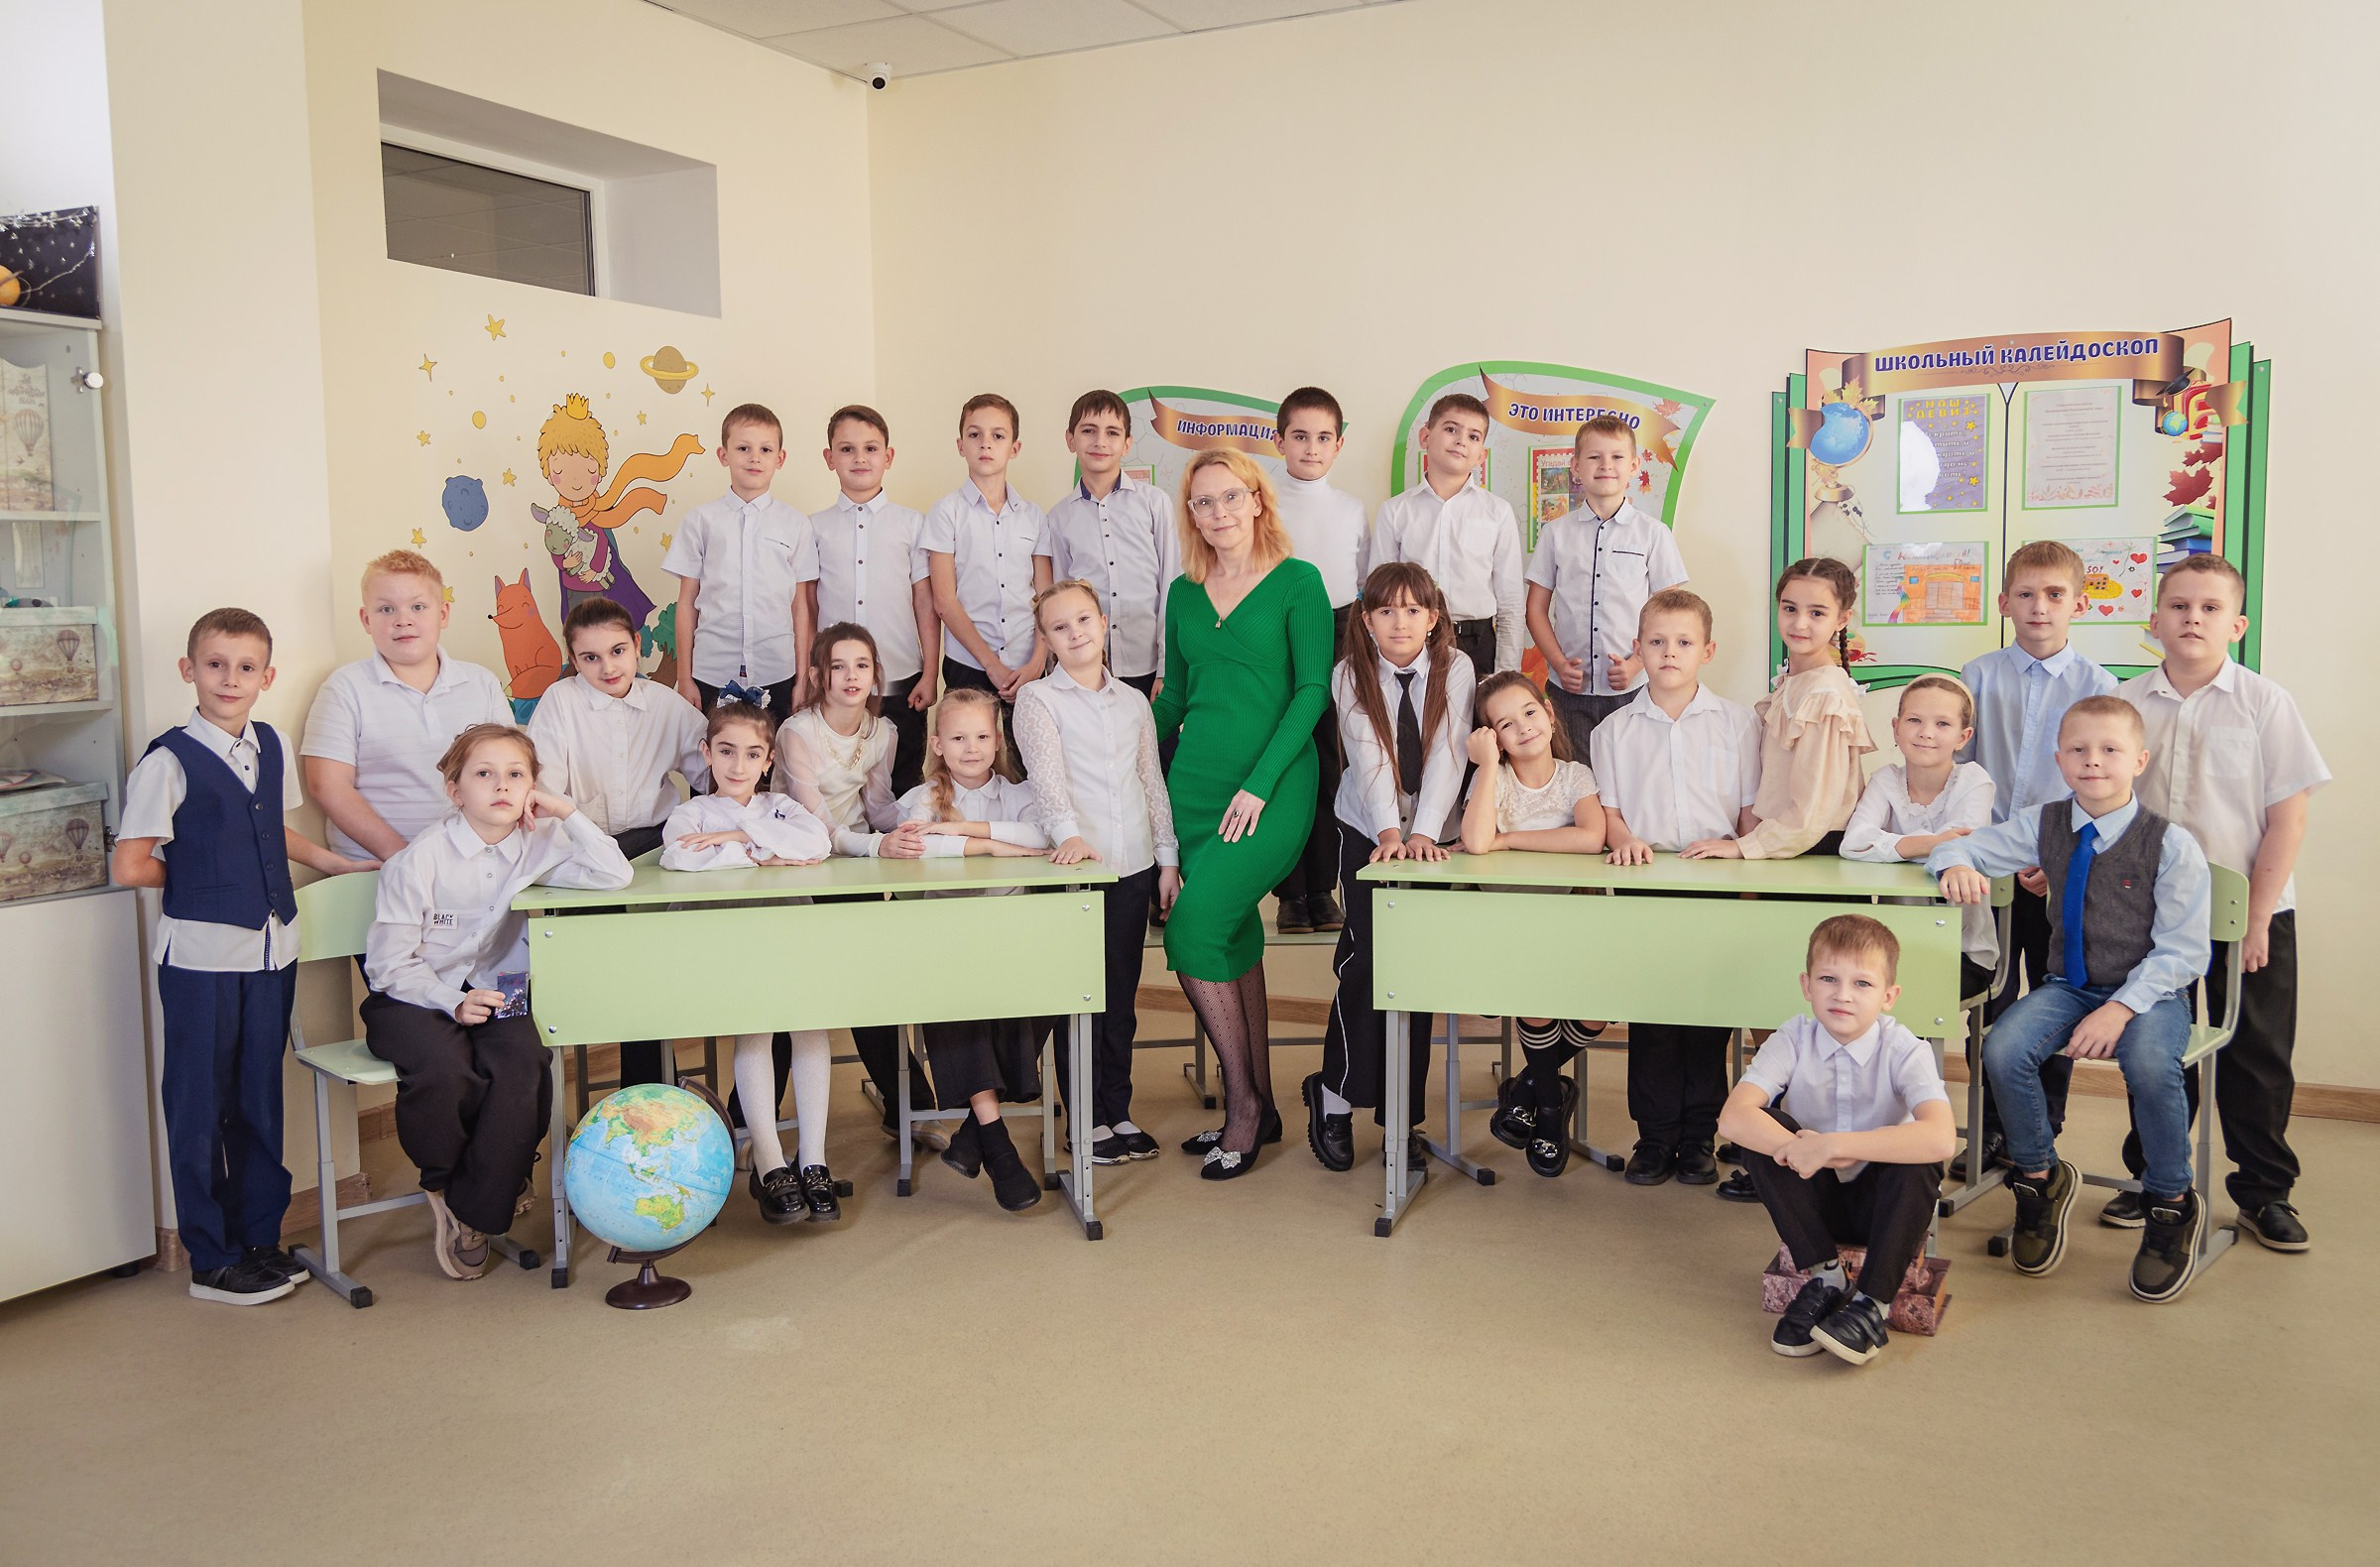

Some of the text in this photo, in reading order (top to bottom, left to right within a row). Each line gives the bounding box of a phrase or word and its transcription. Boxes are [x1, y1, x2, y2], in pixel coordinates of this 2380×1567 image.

[1874, 338, 2159, 372] ШКОЛЬНЫЙ КАЛЕЙДОСКОП
[1925, 399, 1961, 409] НАШ
[1508, 403, 1539, 421] ЭТО
[1916, 407, 1970, 420] ДЕВИЗ
